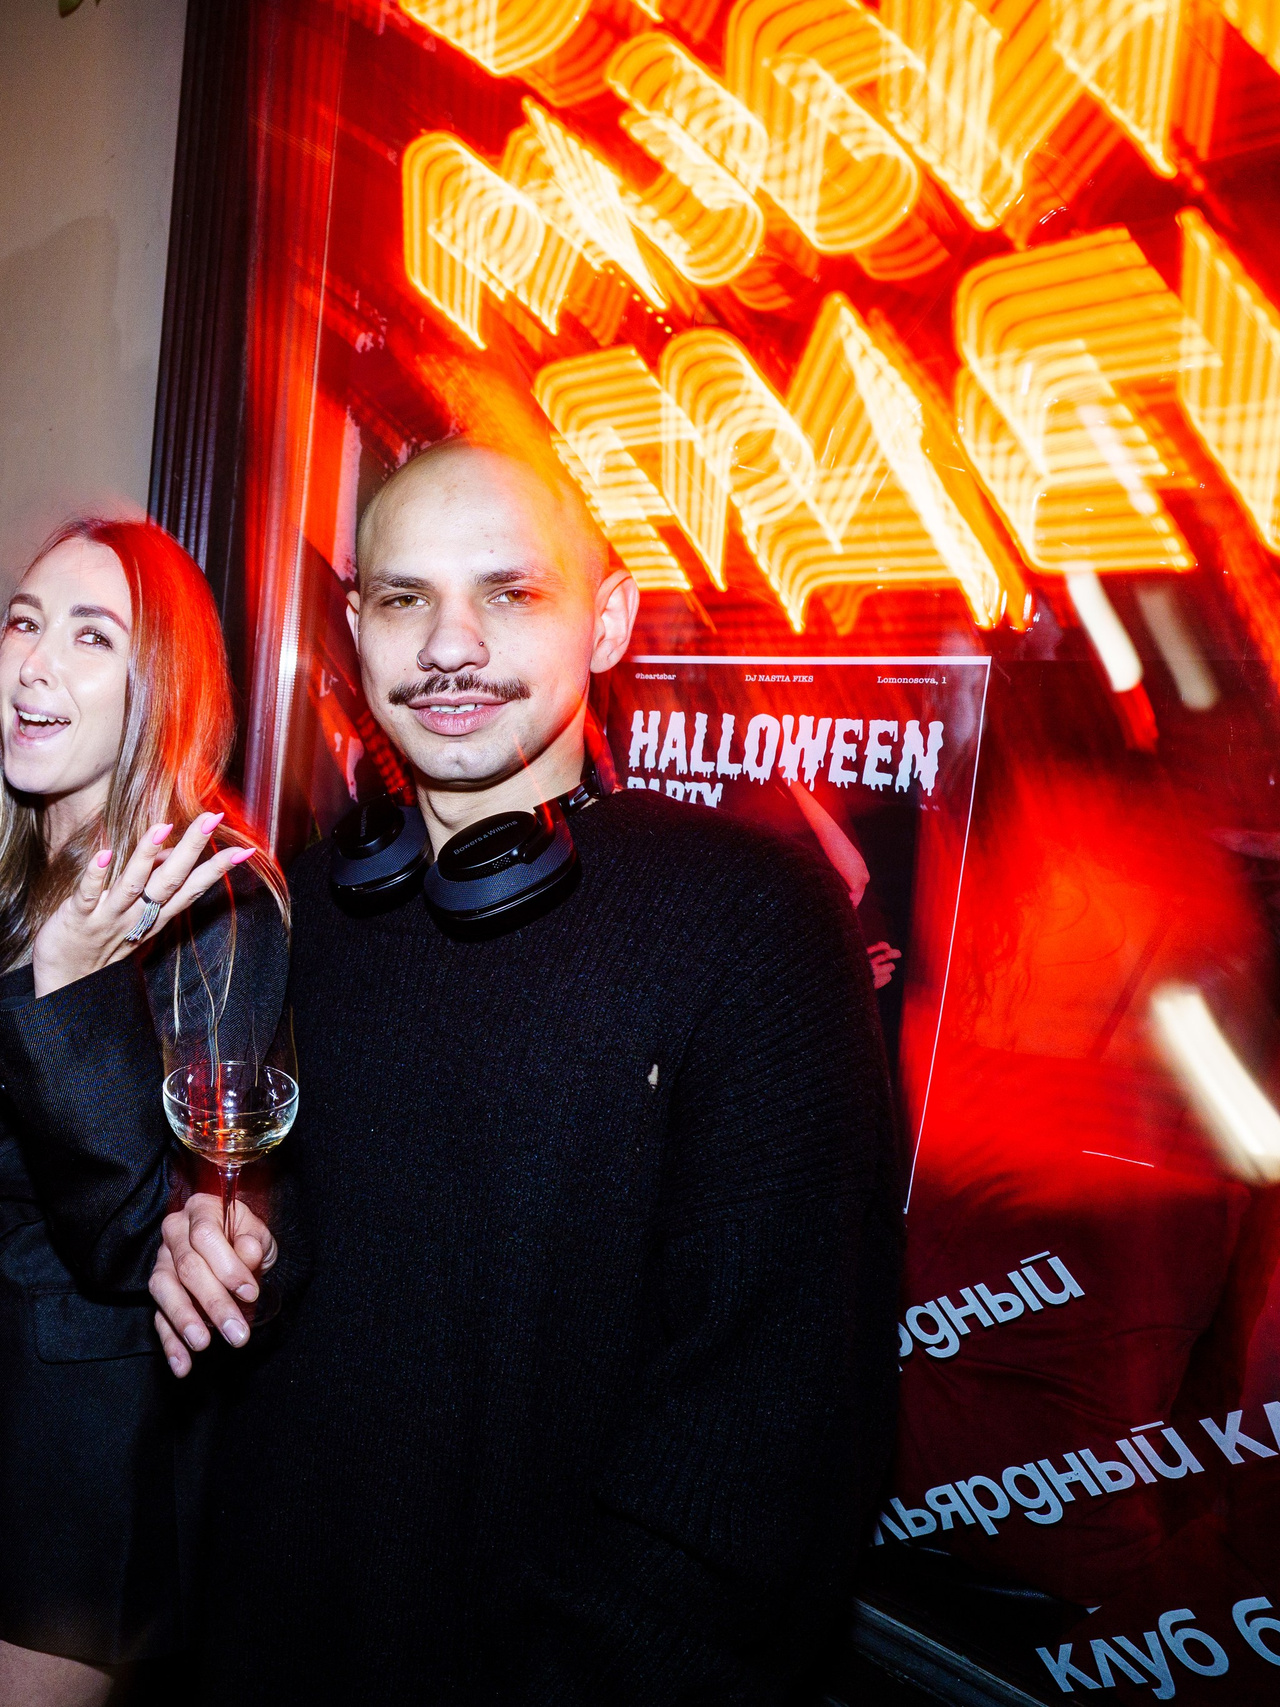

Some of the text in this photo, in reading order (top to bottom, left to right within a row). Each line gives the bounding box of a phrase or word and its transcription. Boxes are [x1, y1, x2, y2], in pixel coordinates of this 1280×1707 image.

[635, 672, 677, 681] @heartsbar
[745, 674, 814, 683] DJ NASTIA FIKS
[877, 675, 939, 686] Lomonosova,
[628, 710, 944, 796] HALLOWEEN
[627, 776, 724, 808] RTY
[1035, 1608, 1229, 1700] клуб
